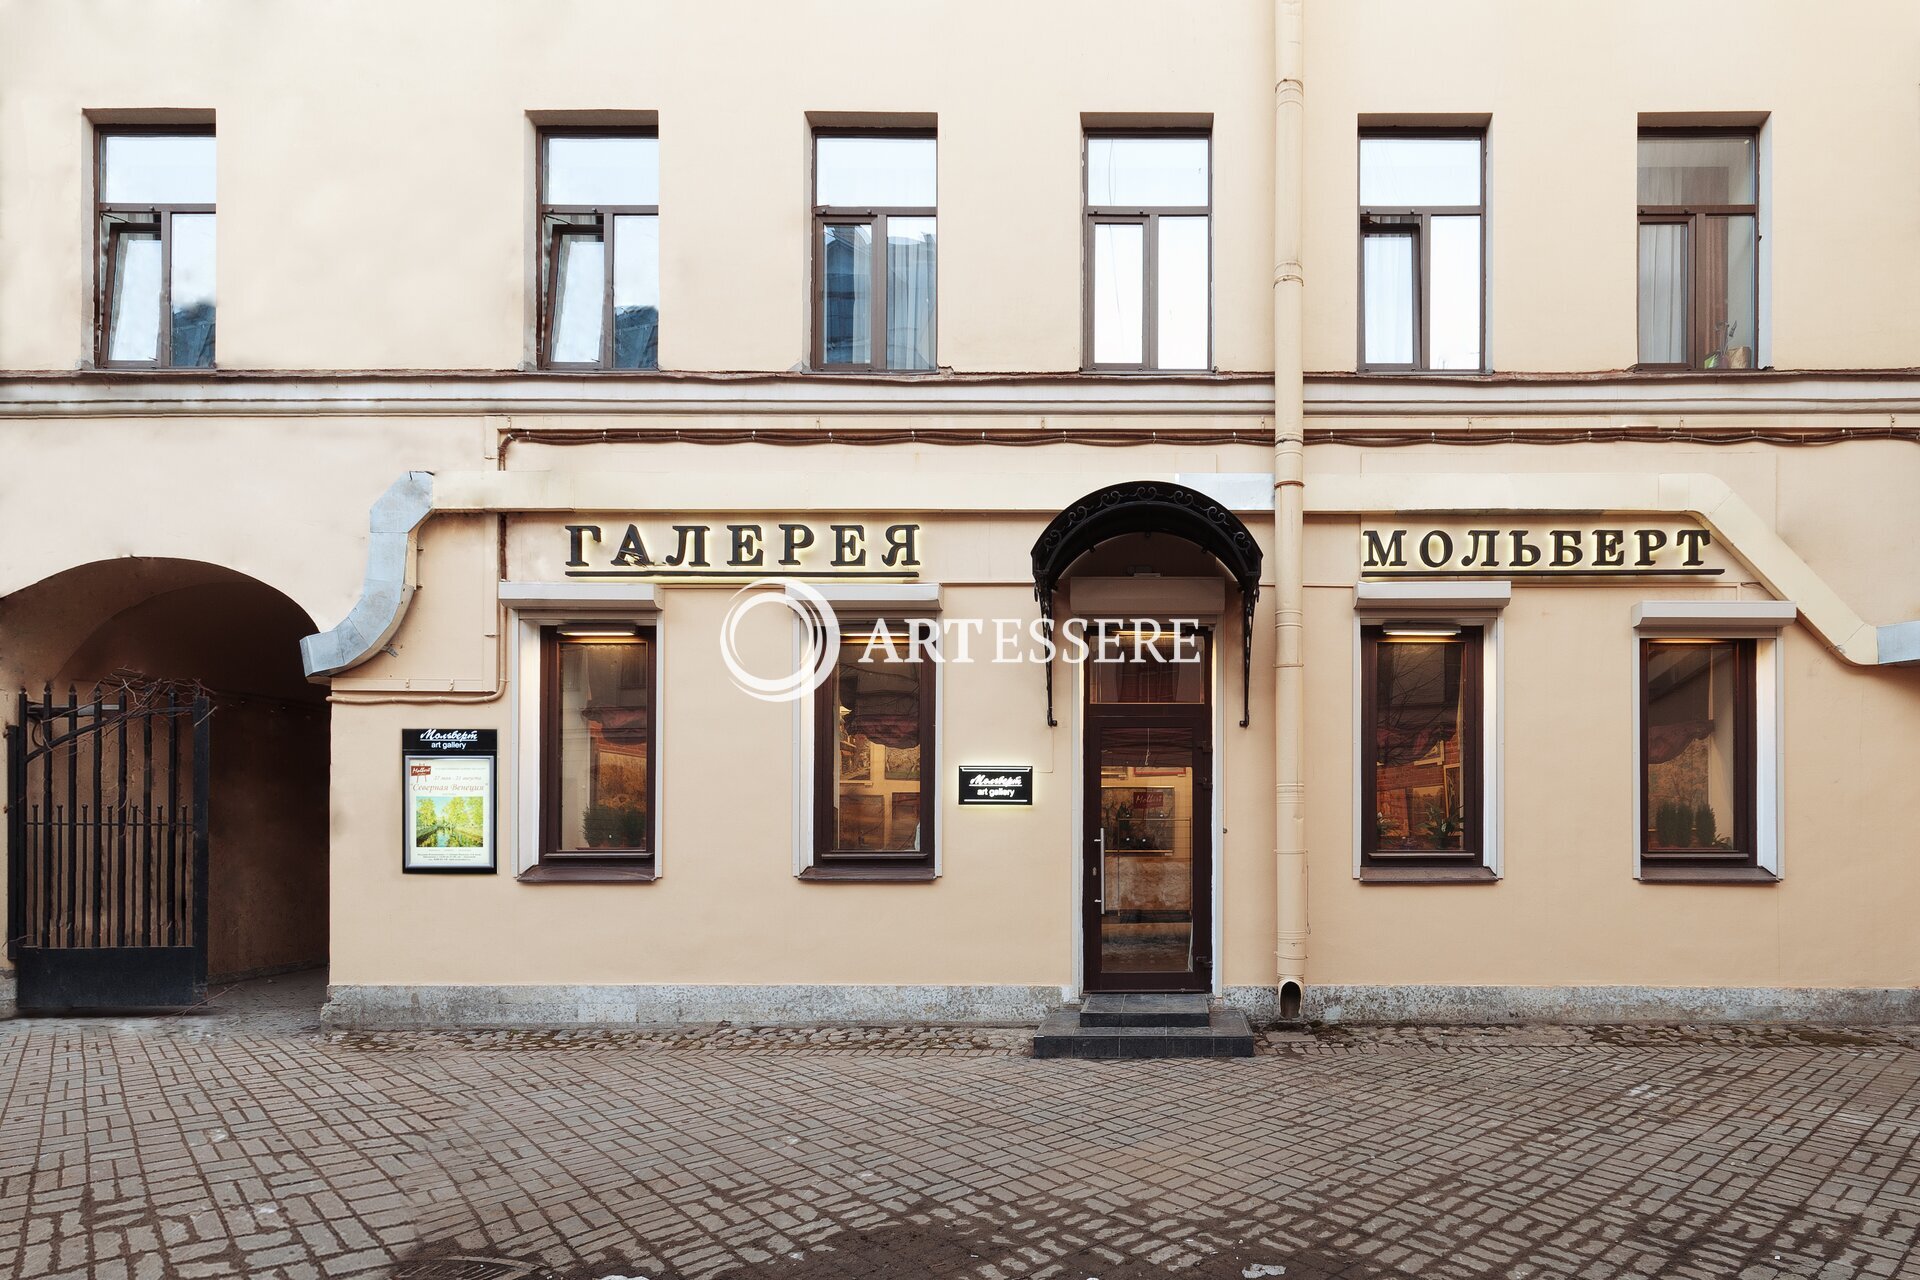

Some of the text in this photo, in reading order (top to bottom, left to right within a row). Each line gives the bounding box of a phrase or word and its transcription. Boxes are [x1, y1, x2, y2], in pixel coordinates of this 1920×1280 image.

[565, 523, 921, 567] ГАЛЕРЕЯ
[1362, 529, 1711, 568] МОЛЬБЕРТ
[442, 741, 467, 750] gallery
[977, 787, 1015, 797] art gallery
